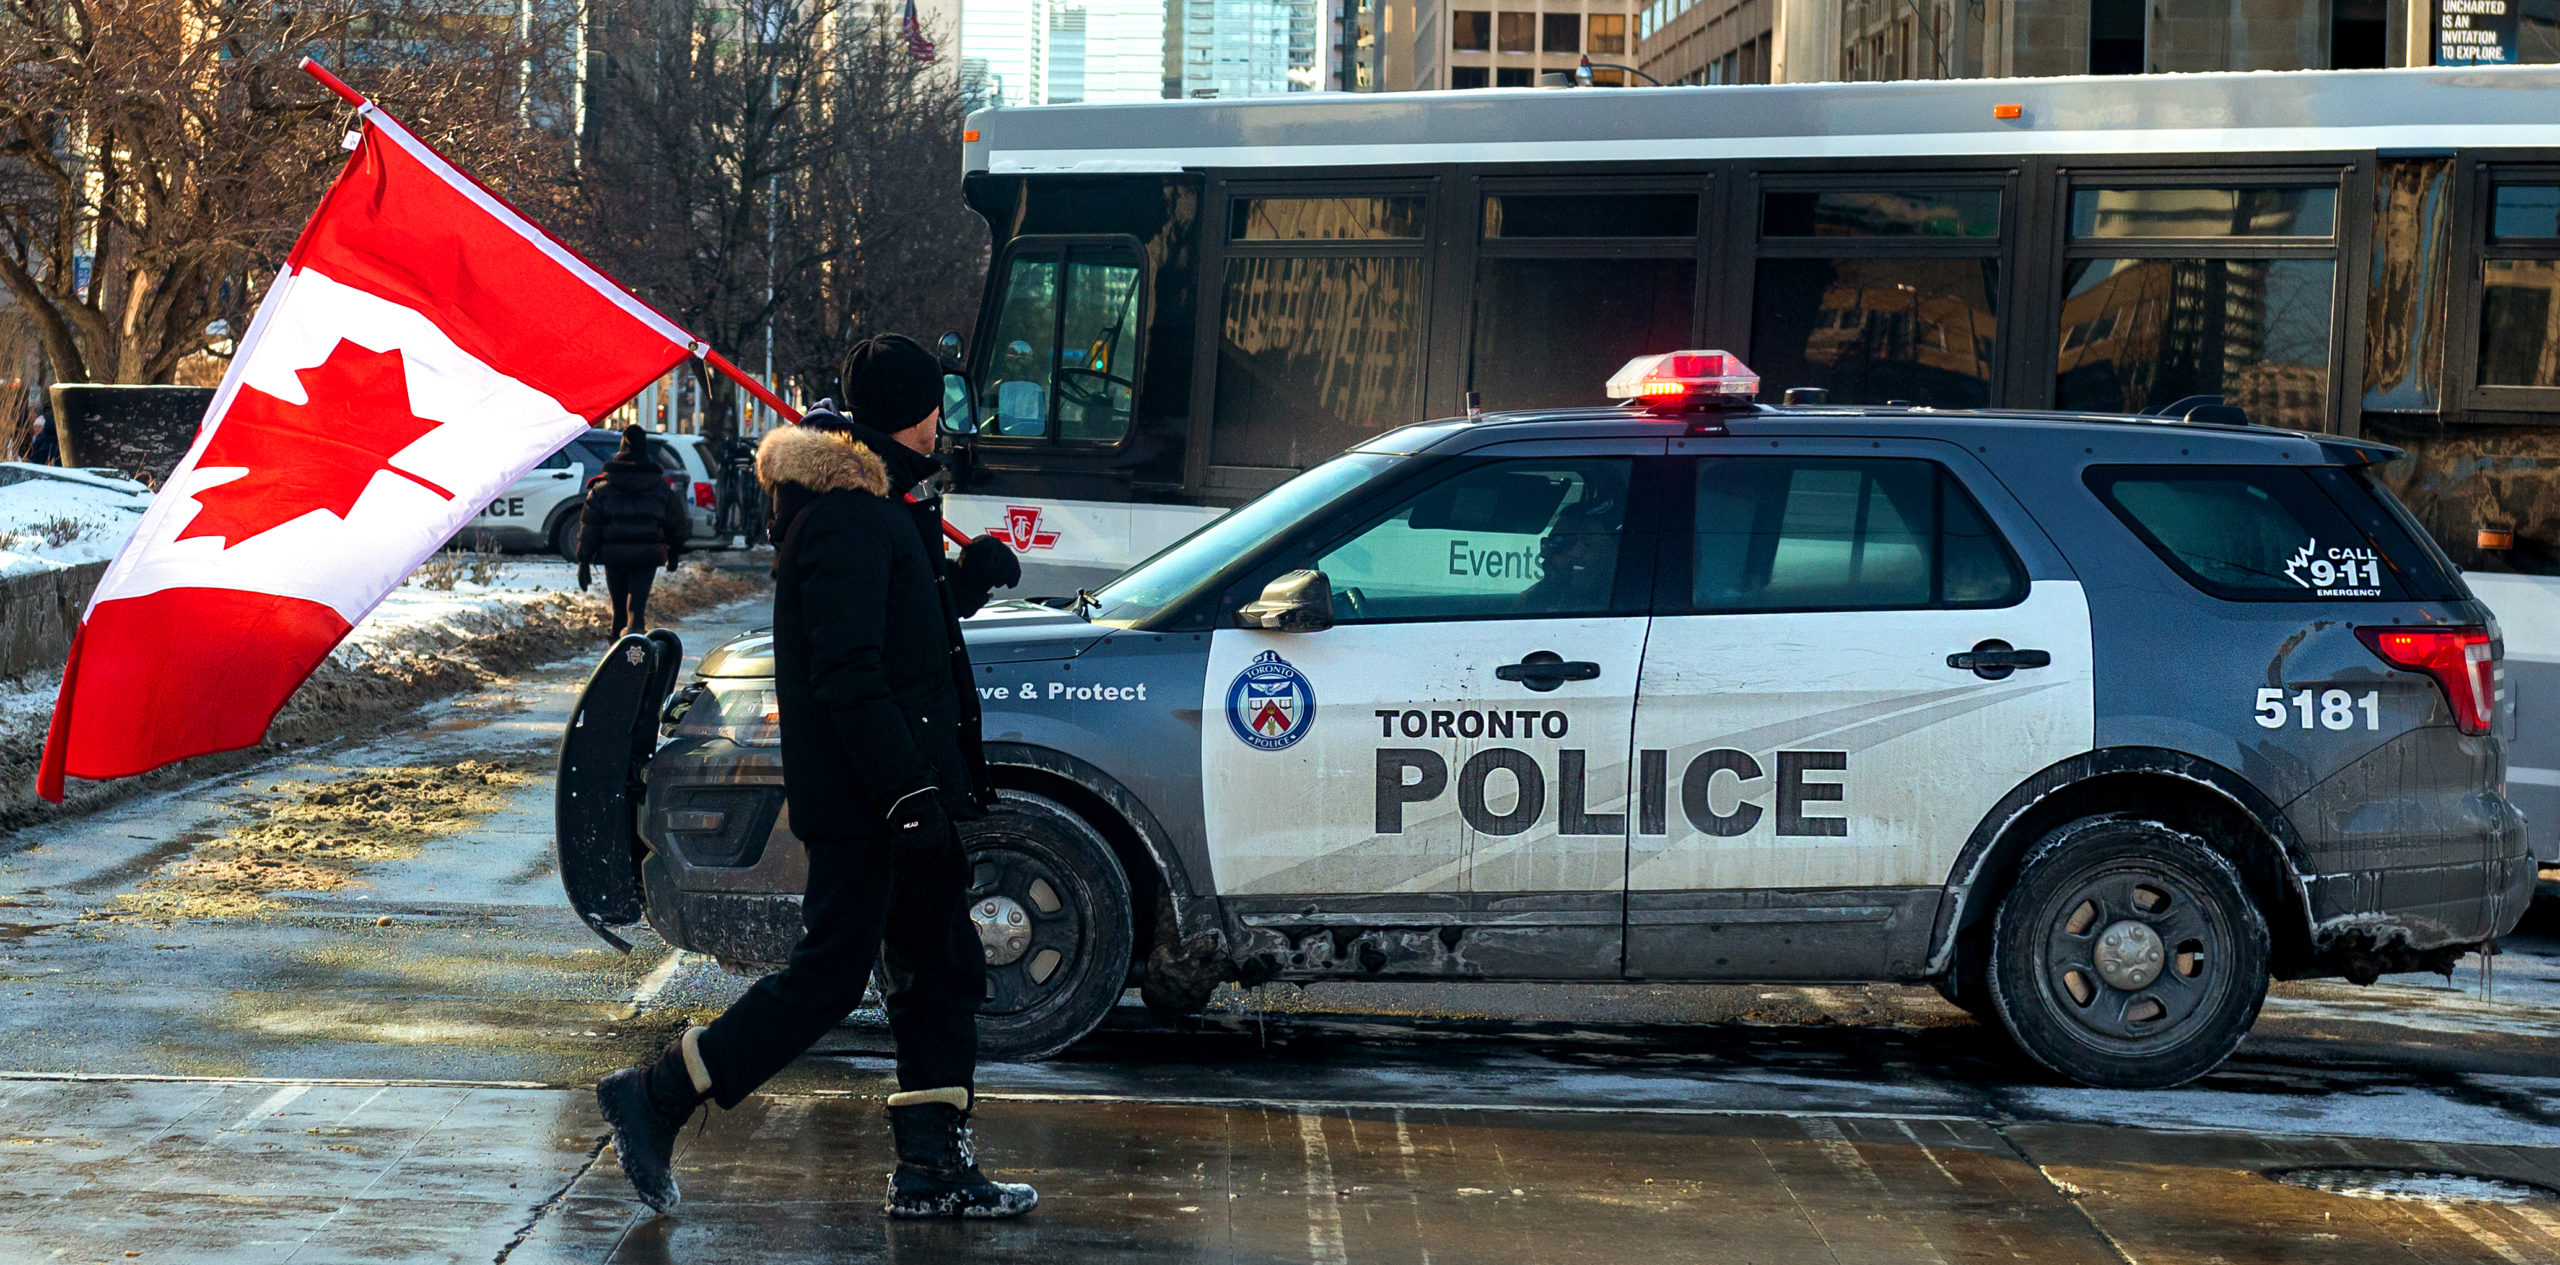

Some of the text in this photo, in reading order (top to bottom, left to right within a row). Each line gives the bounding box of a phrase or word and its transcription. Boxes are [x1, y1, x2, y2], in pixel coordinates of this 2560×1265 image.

[2442, 0, 2505, 14] UNCHARTED
[2442, 14, 2470, 29] IS AN
[2442, 30, 2497, 44] INVITATION
[2442, 45, 2505, 60] TO EXPLORE.
[1449, 539, 1545, 580] Events
[2328, 547, 2378, 560] CALL
[2310, 560, 2380, 587] 9-1-1
[1245, 665, 1294, 679] TORONTO
[977, 682, 1147, 701] ve & Protect
[2254, 688, 2379, 731] 5181
[1374, 709, 1569, 739] TORONTO
[1254, 737, 1290, 748] POLICE
[1375, 747, 1849, 837] POLICE
